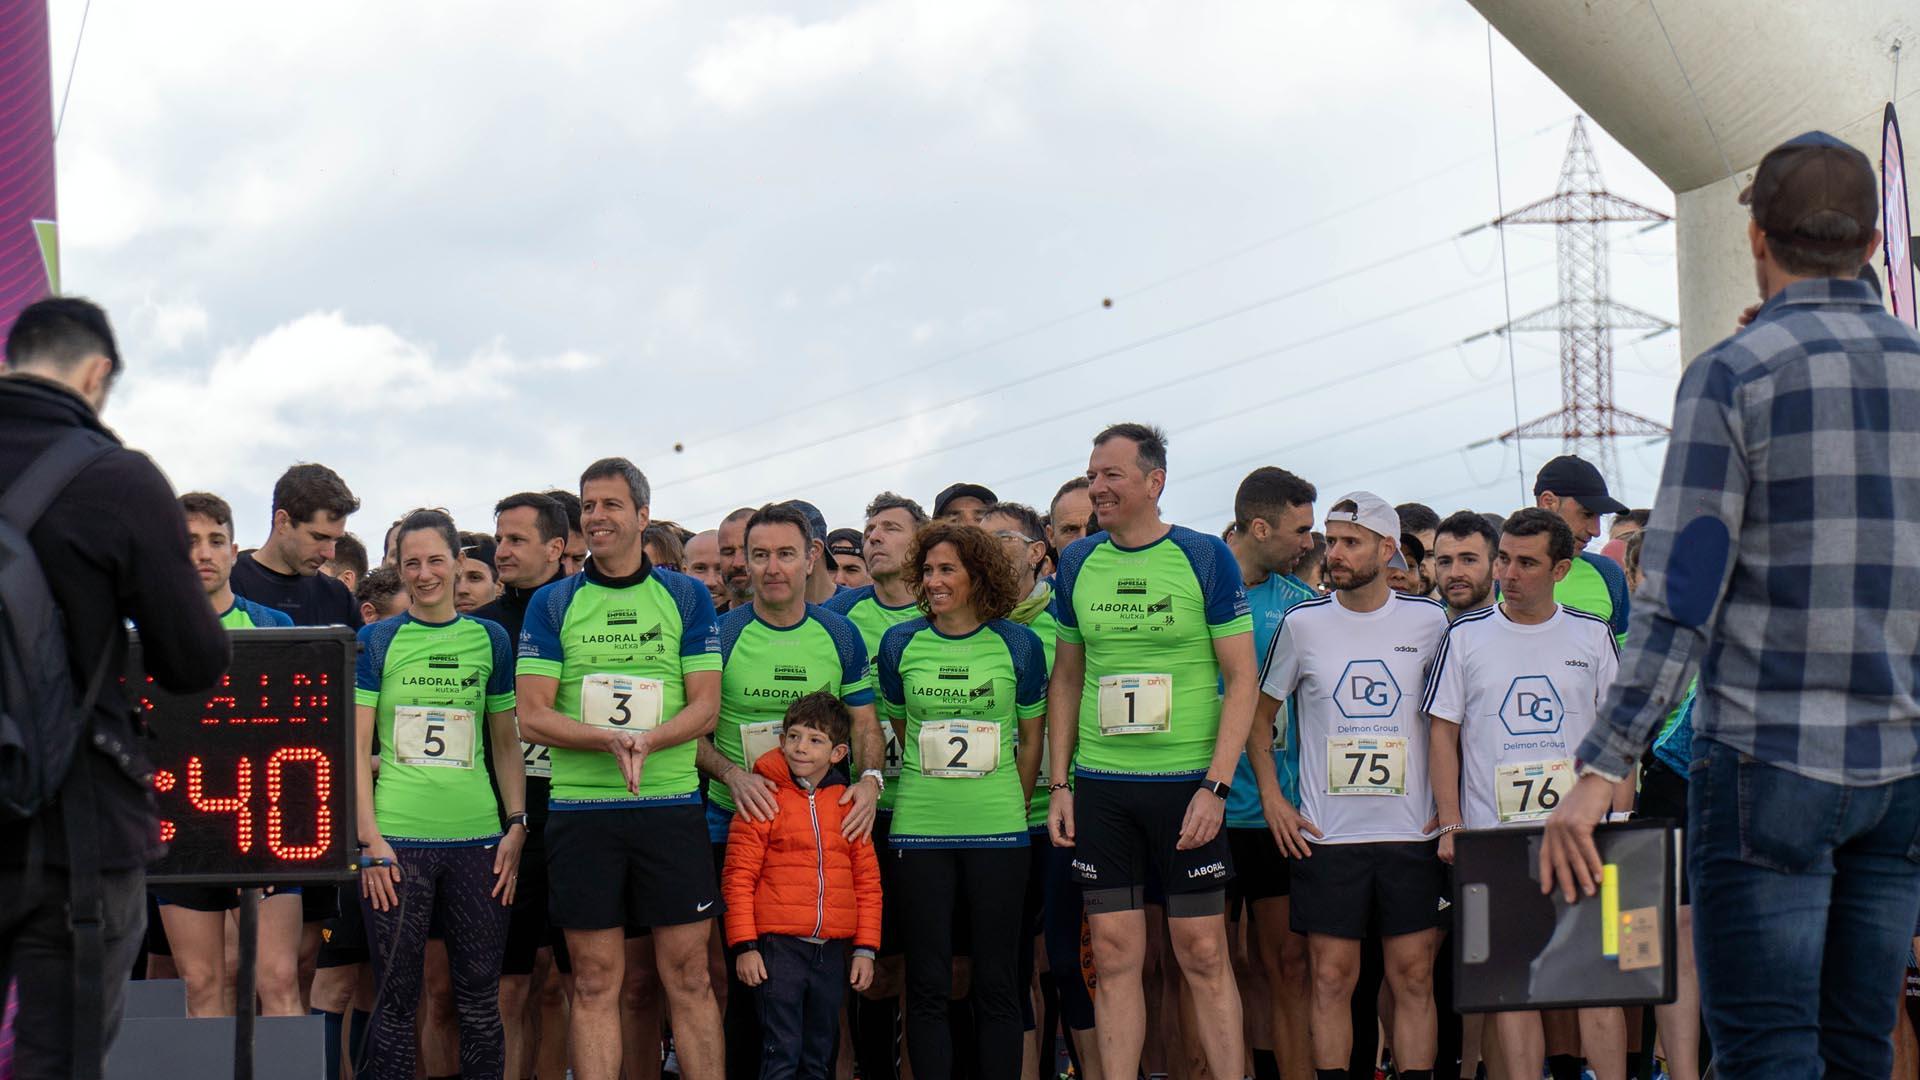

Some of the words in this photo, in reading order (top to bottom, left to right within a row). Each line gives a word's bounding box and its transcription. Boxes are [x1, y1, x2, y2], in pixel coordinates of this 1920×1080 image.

[1090, 603, 1145, 613] LABORAL
[582, 633, 638, 644] LABORAL
[1565, 660, 1589, 668] adidas
[402, 676, 460, 687] LABORAL
[911, 685, 968, 697] LABORAL
[1351, 675, 1388, 707] DG
[608, 692, 633, 726] 3
[1124, 691, 1135, 724] 1
[1517, 692, 1553, 723] DG
[423, 725, 446, 757] 5
[1337, 725, 1372, 733] Delmon
[1373, 725, 1399, 734] Group
[946, 736, 969, 768] 2
[1504, 742, 1538, 751] Delmon
[1540, 741, 1566, 749] Group
[1345, 753, 1391, 785] 75
[1512, 776, 1560, 810] 76
[1188, 861, 1226, 879] LABORAL
